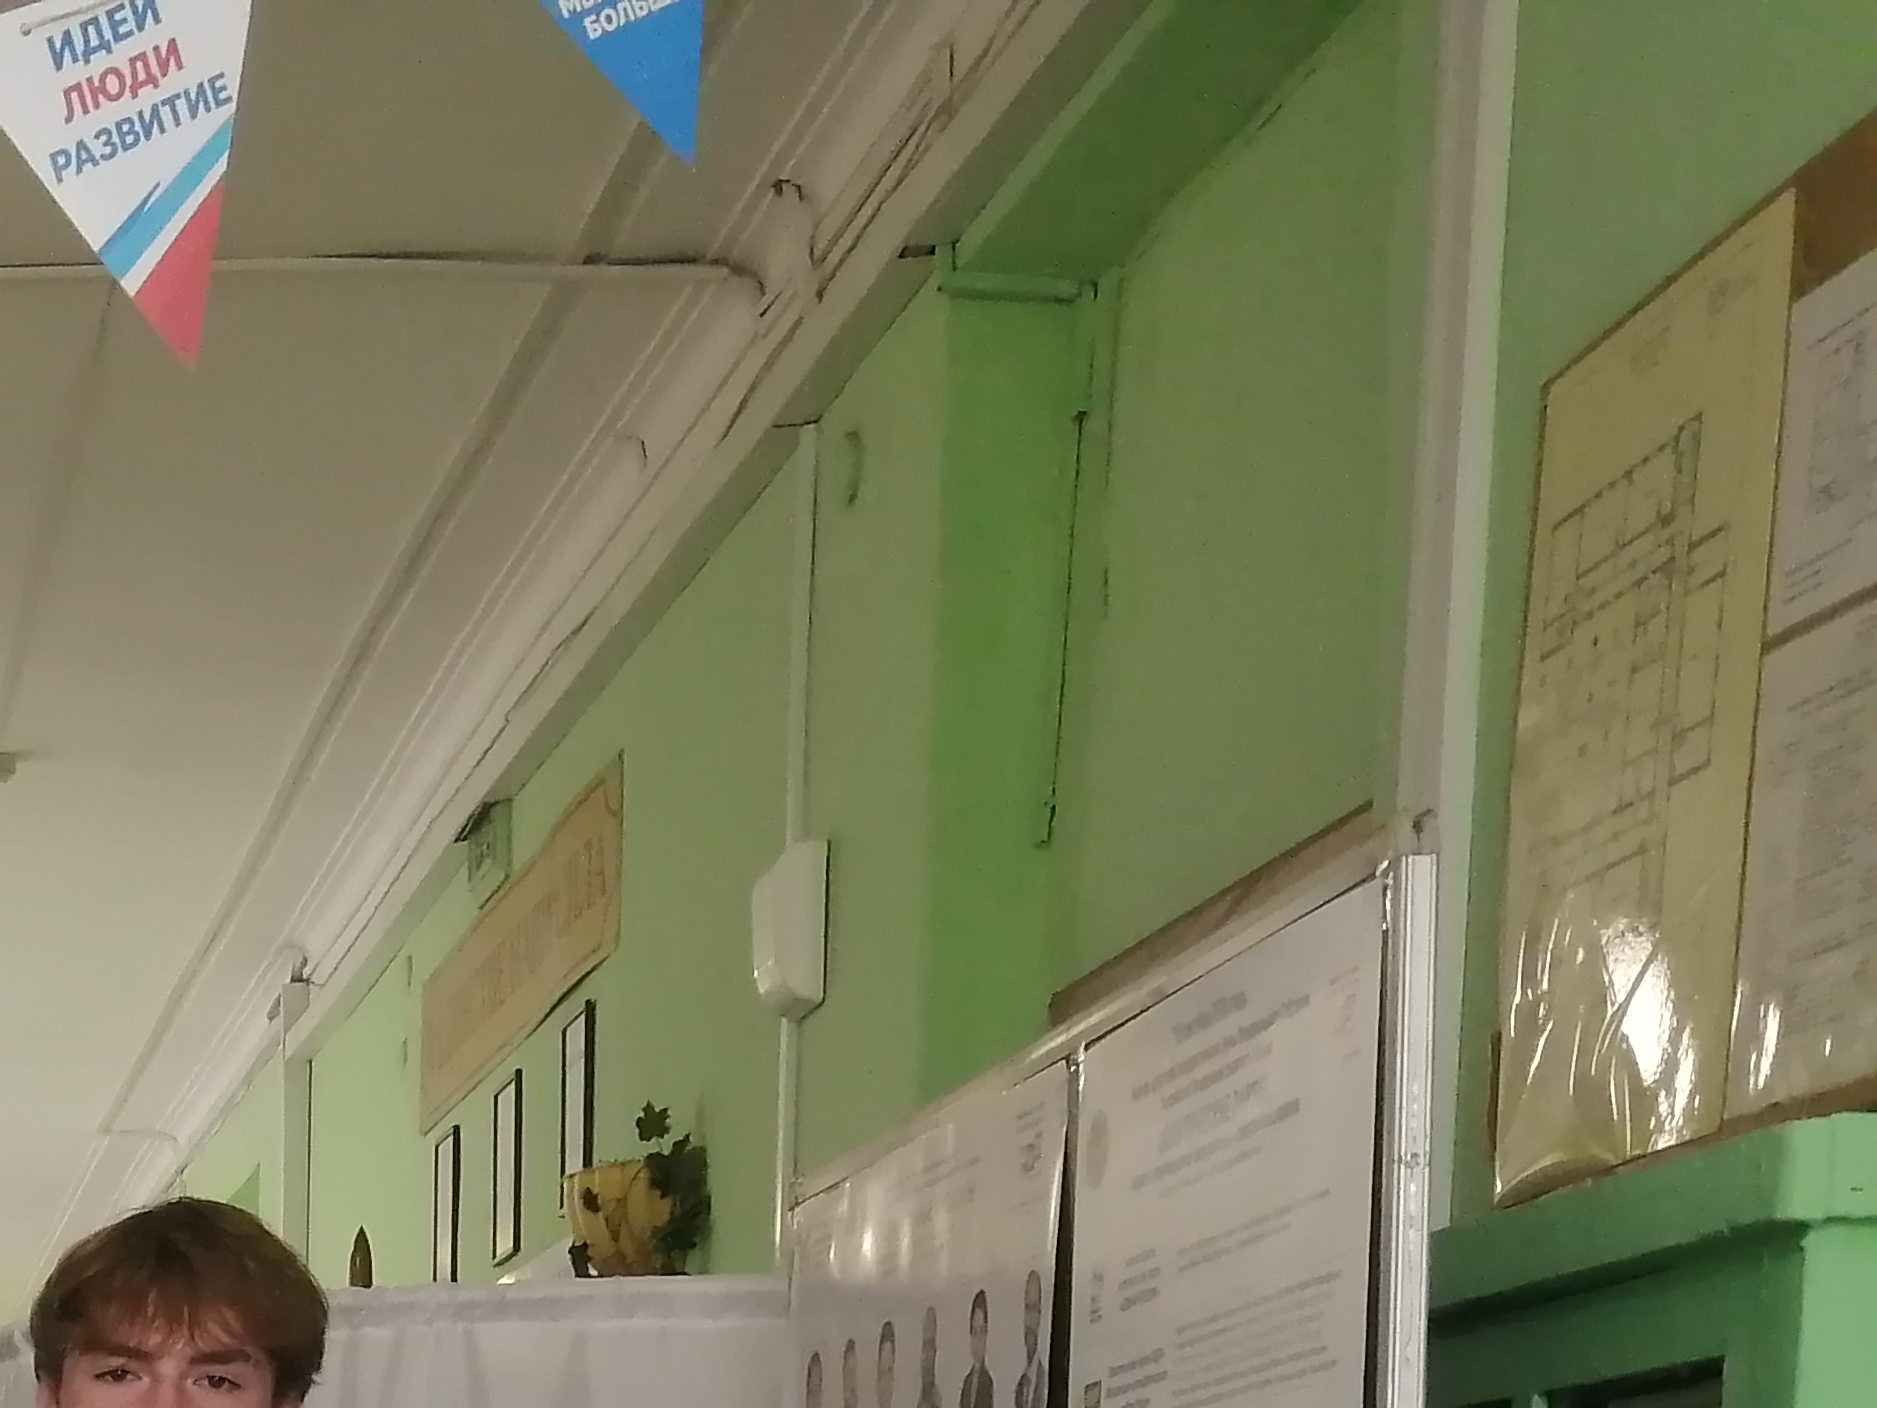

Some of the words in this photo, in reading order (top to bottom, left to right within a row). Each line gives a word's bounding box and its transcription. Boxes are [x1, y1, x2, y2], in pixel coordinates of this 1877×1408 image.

[46, 0, 162, 73] ИДЕИ
[62, 37, 185, 125] ЛЮДИ
[49, 71, 233, 185] РАЗВИТИЕ
